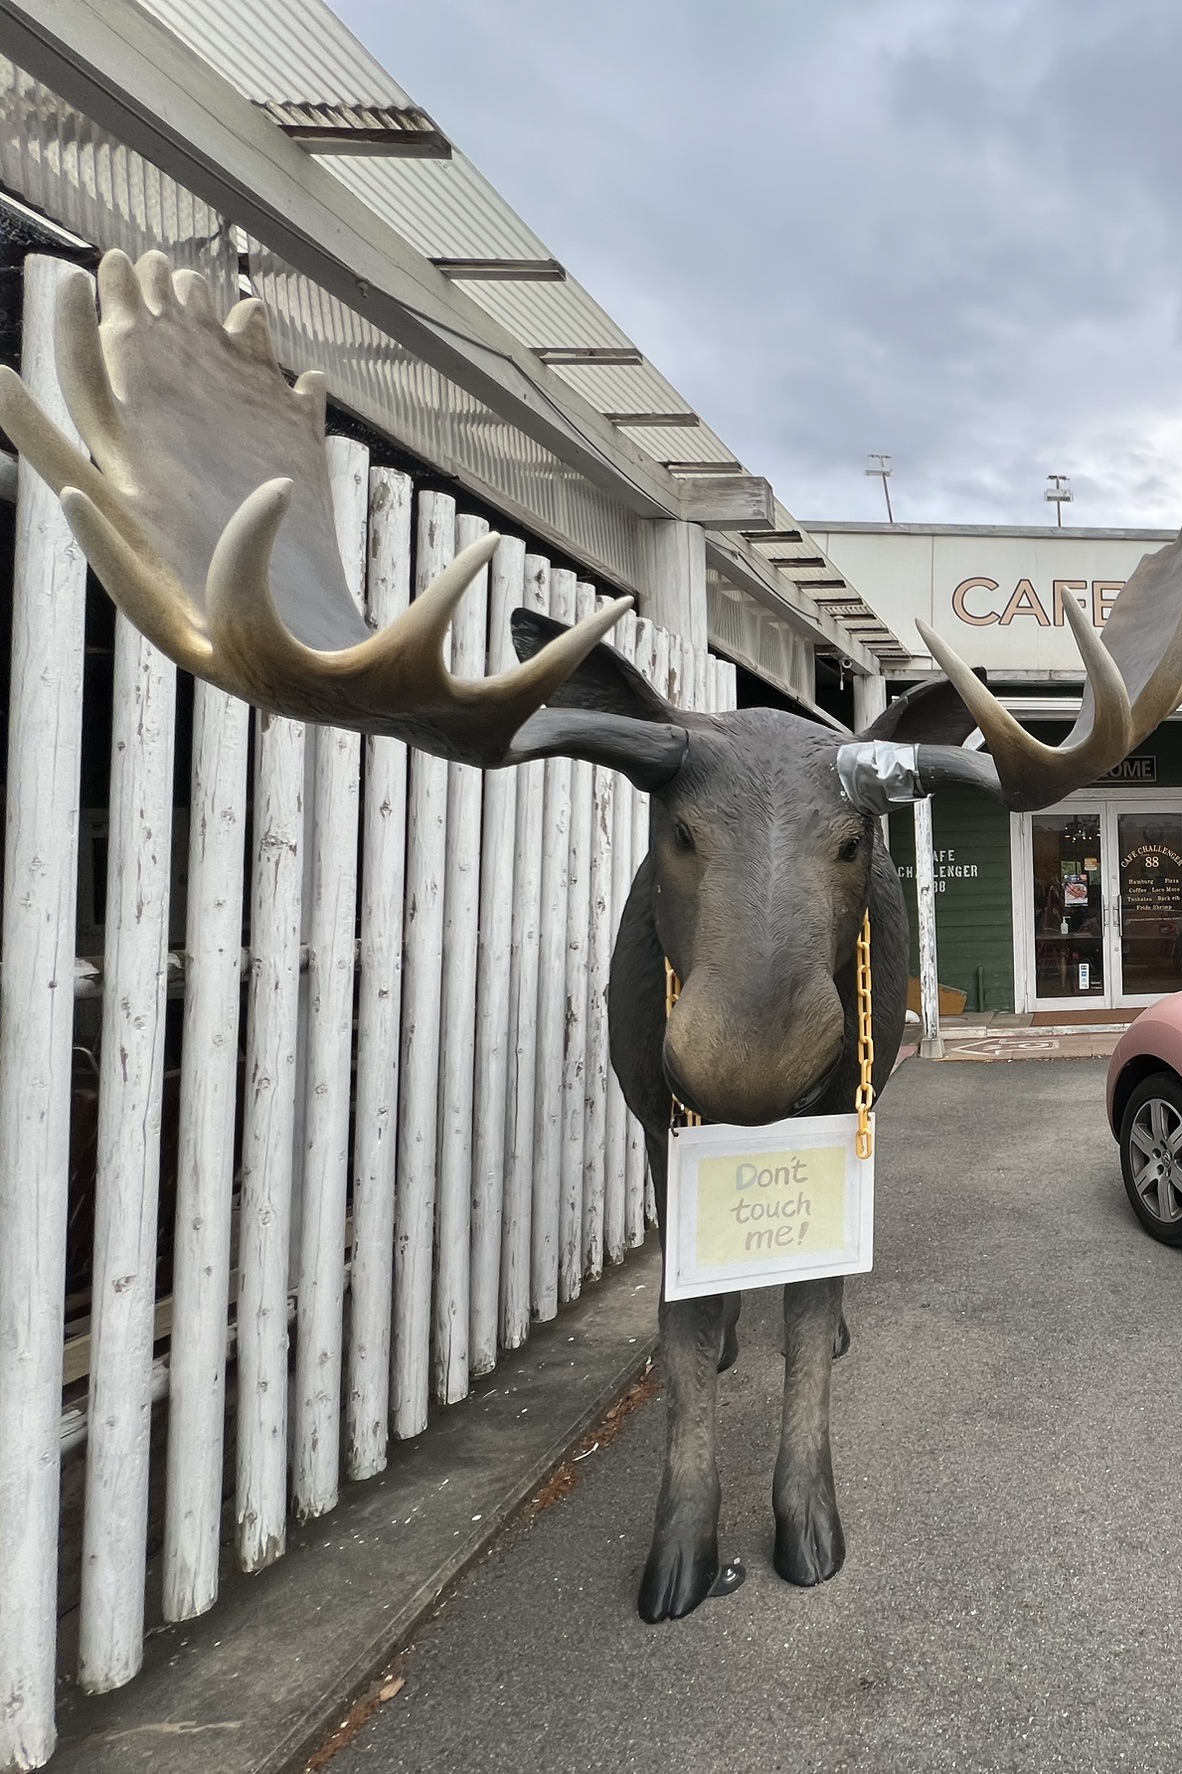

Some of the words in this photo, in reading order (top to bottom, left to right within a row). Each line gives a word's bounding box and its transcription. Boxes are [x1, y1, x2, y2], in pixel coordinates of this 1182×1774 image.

[952, 576, 1126, 628] CAFE
[933, 850, 955, 862] AFE
[1120, 850, 1138, 868] CAFE
[1145, 856, 1159, 868] 88
[735, 1155, 809, 1191] Don't
[729, 1191, 811, 1224] touch
[745, 1221, 809, 1251] me!
